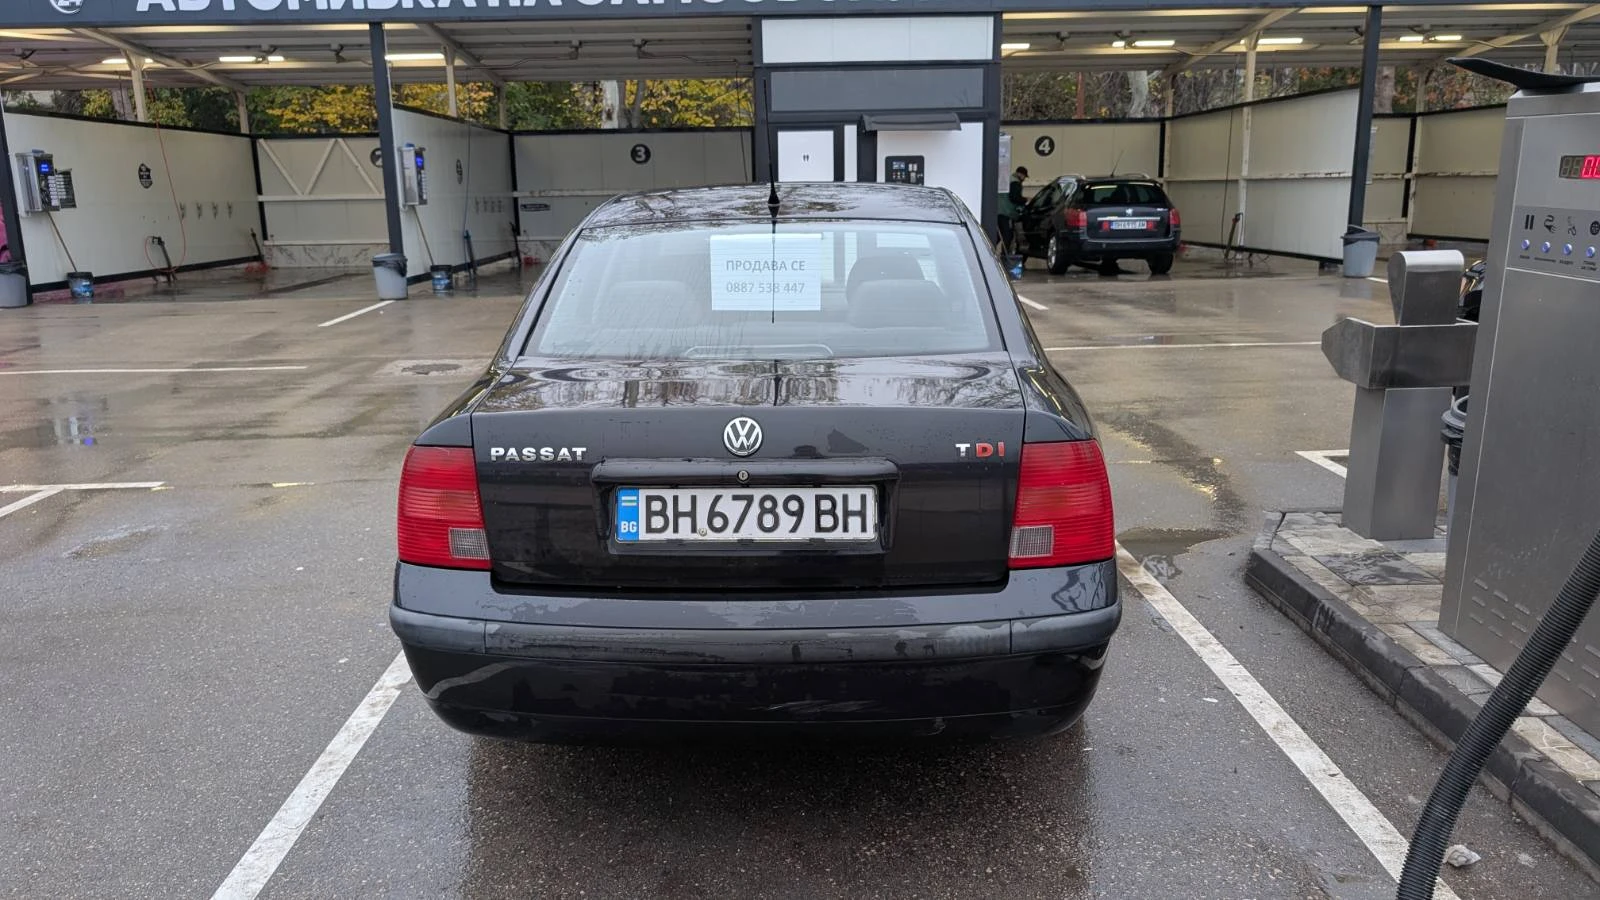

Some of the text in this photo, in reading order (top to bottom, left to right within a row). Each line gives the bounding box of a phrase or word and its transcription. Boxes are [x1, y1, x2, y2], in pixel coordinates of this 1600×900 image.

[635, 146, 646, 161] 3
[1039, 139, 1050, 154] 4
[726, 260, 806, 273] ПРОДАВА СЕ
[726, 282, 754, 293] 0887
[783, 282, 805, 294] 447
[490, 447, 587, 462] PASSAT
[955, 442, 1006, 458] TDI
[620, 521, 638, 533] BG
